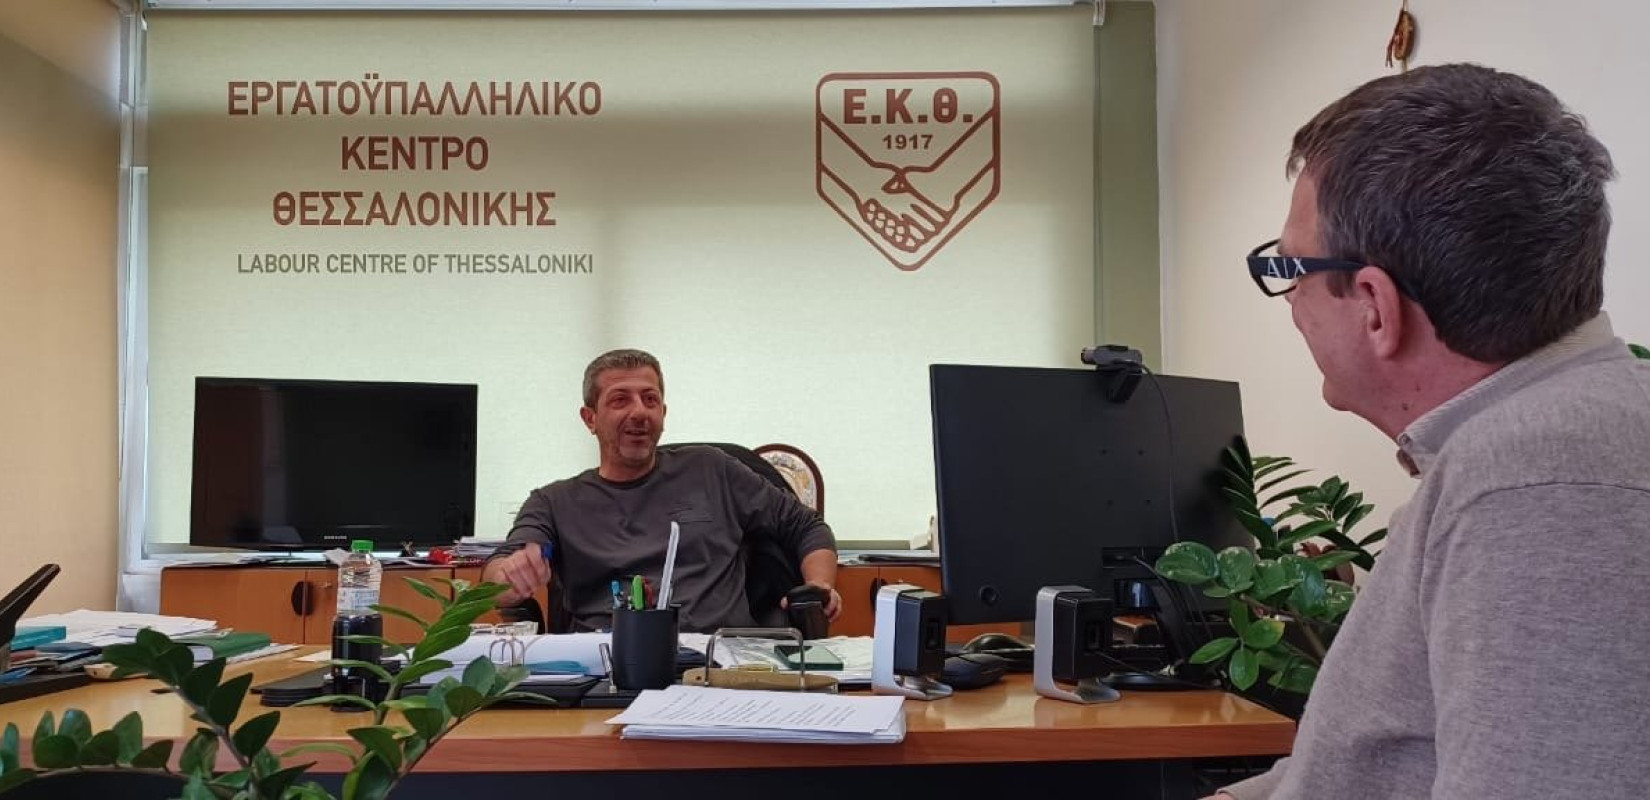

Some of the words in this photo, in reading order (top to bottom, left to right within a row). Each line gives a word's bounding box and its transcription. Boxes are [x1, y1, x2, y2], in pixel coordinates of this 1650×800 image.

[227, 73, 602, 116] ΕΡΓΑΤΟΫΠΑΛΛΗΛΙΚΟ
[341, 136, 489, 171] ΚΕΝΤΡΟ
[882, 134, 933, 150] 1917
[273, 191, 557, 226] ΘΕΣΣΑΛΟΝΙΚΗΣ
[237, 253, 320, 274] LABOUR
[327, 253, 407, 274] CENTRE
[412, 253, 439, 274] OF
[443, 253, 594, 275] THESSALONIKI
